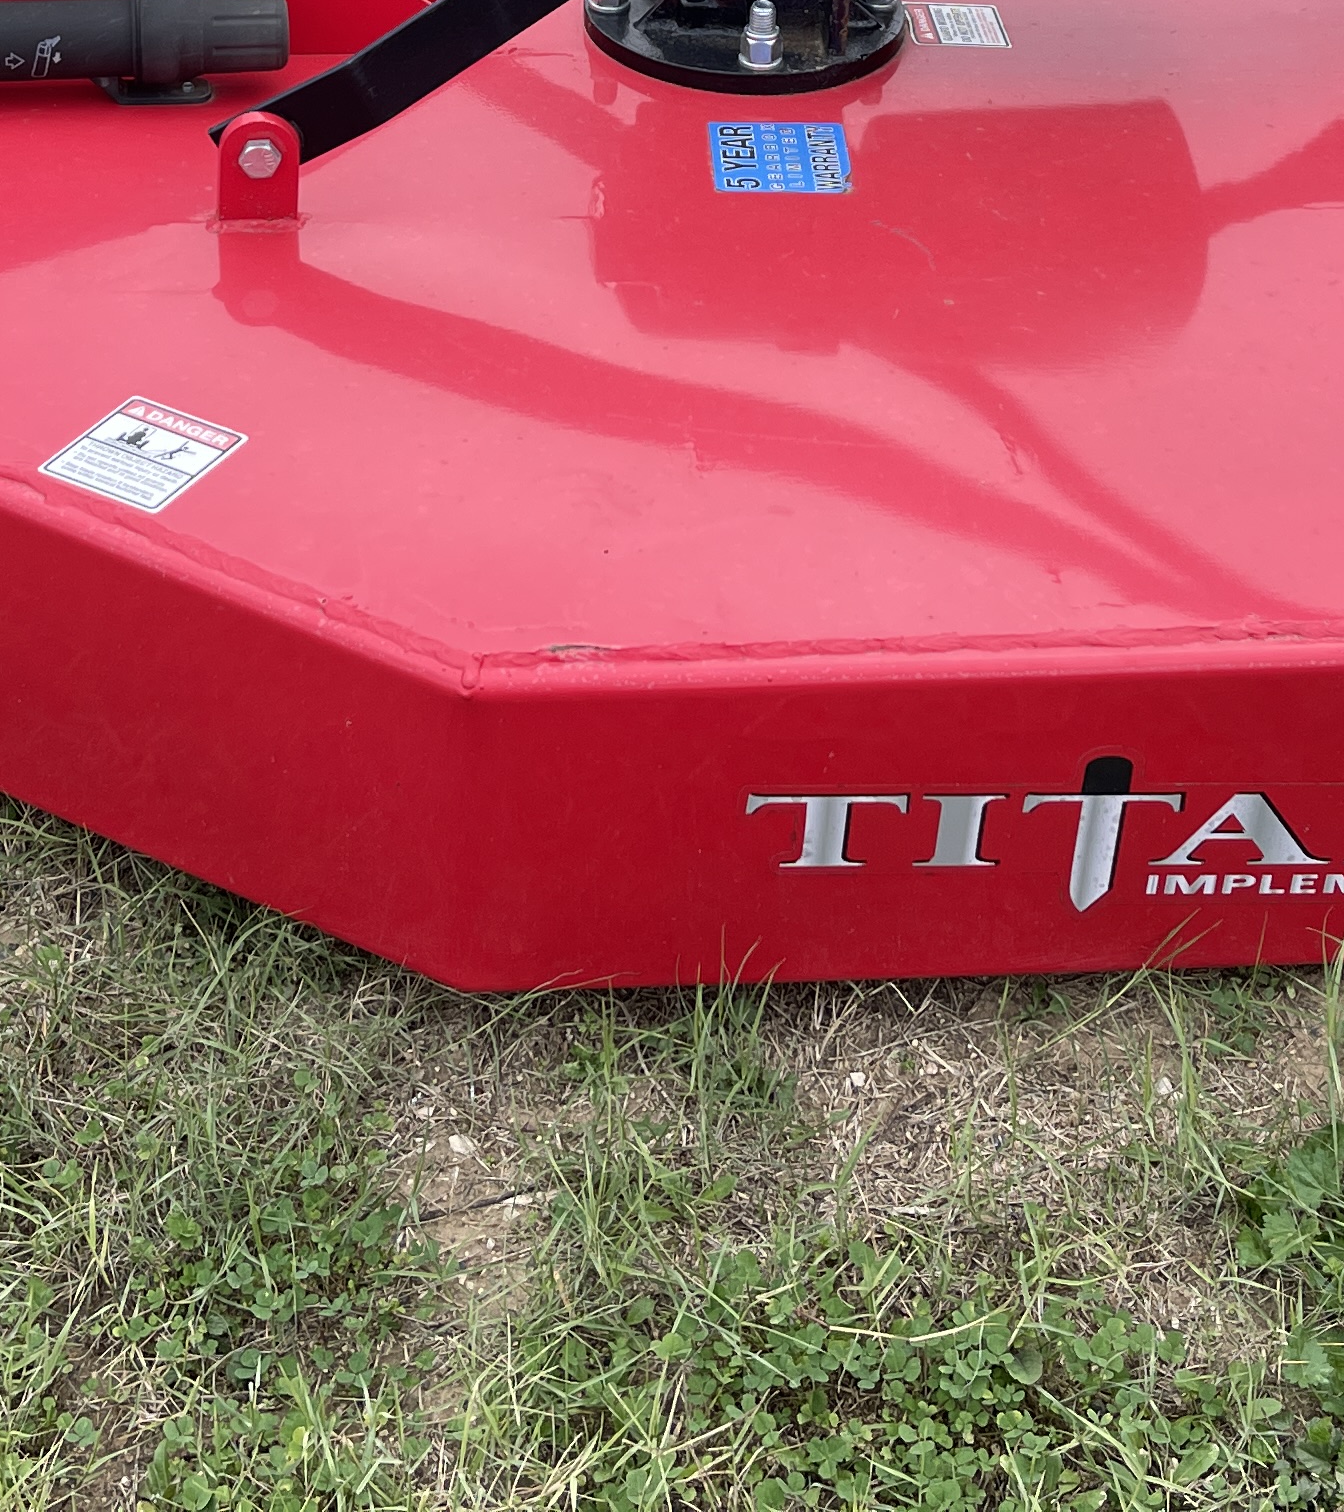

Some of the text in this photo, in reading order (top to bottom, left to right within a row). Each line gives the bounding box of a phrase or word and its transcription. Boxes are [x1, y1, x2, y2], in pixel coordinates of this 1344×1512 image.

[719, 126, 760, 190] 5 YEAR
[805, 125, 844, 191] WARRANTY
[145, 410, 230, 447] DANGER
